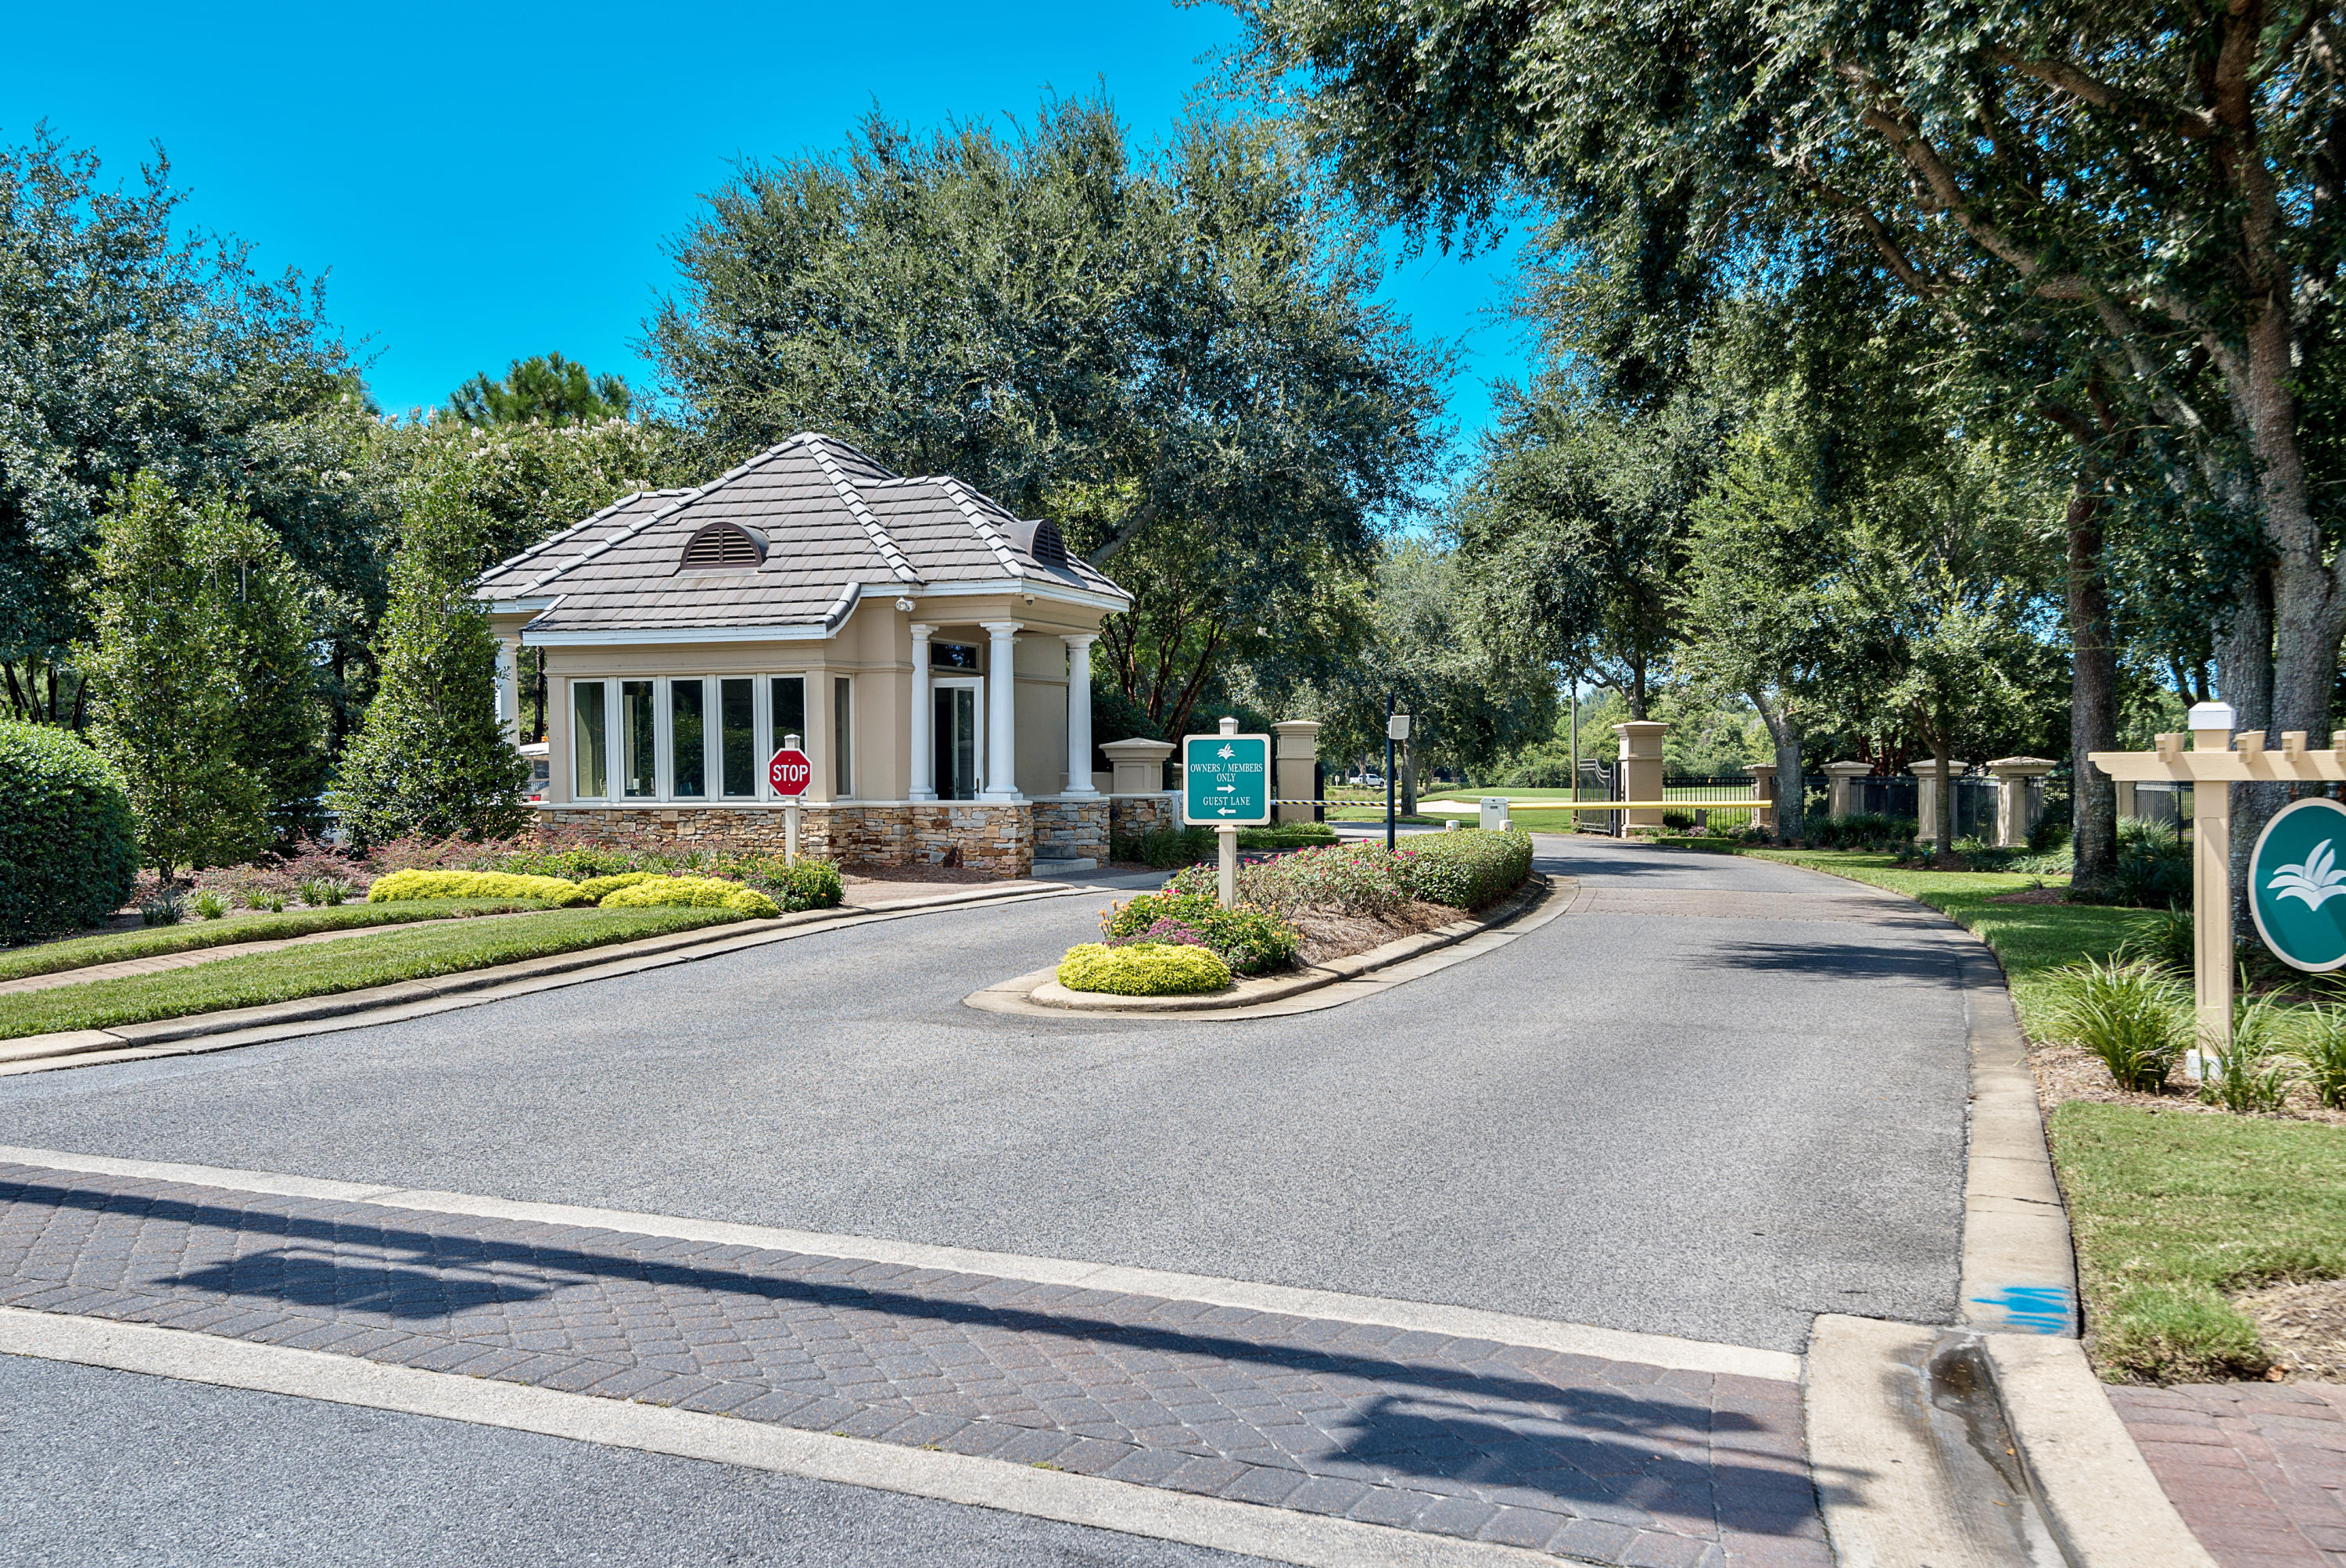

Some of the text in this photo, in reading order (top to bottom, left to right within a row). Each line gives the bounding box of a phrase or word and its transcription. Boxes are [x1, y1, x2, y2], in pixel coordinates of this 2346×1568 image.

[773, 764, 809, 782] STOP
[1190, 763, 1220, 773] OWNERS
[1228, 763, 1263, 773] MEMBERS
[1217, 773, 1236, 782] ONLY
[1203, 796, 1250, 806] GUEST LANE
